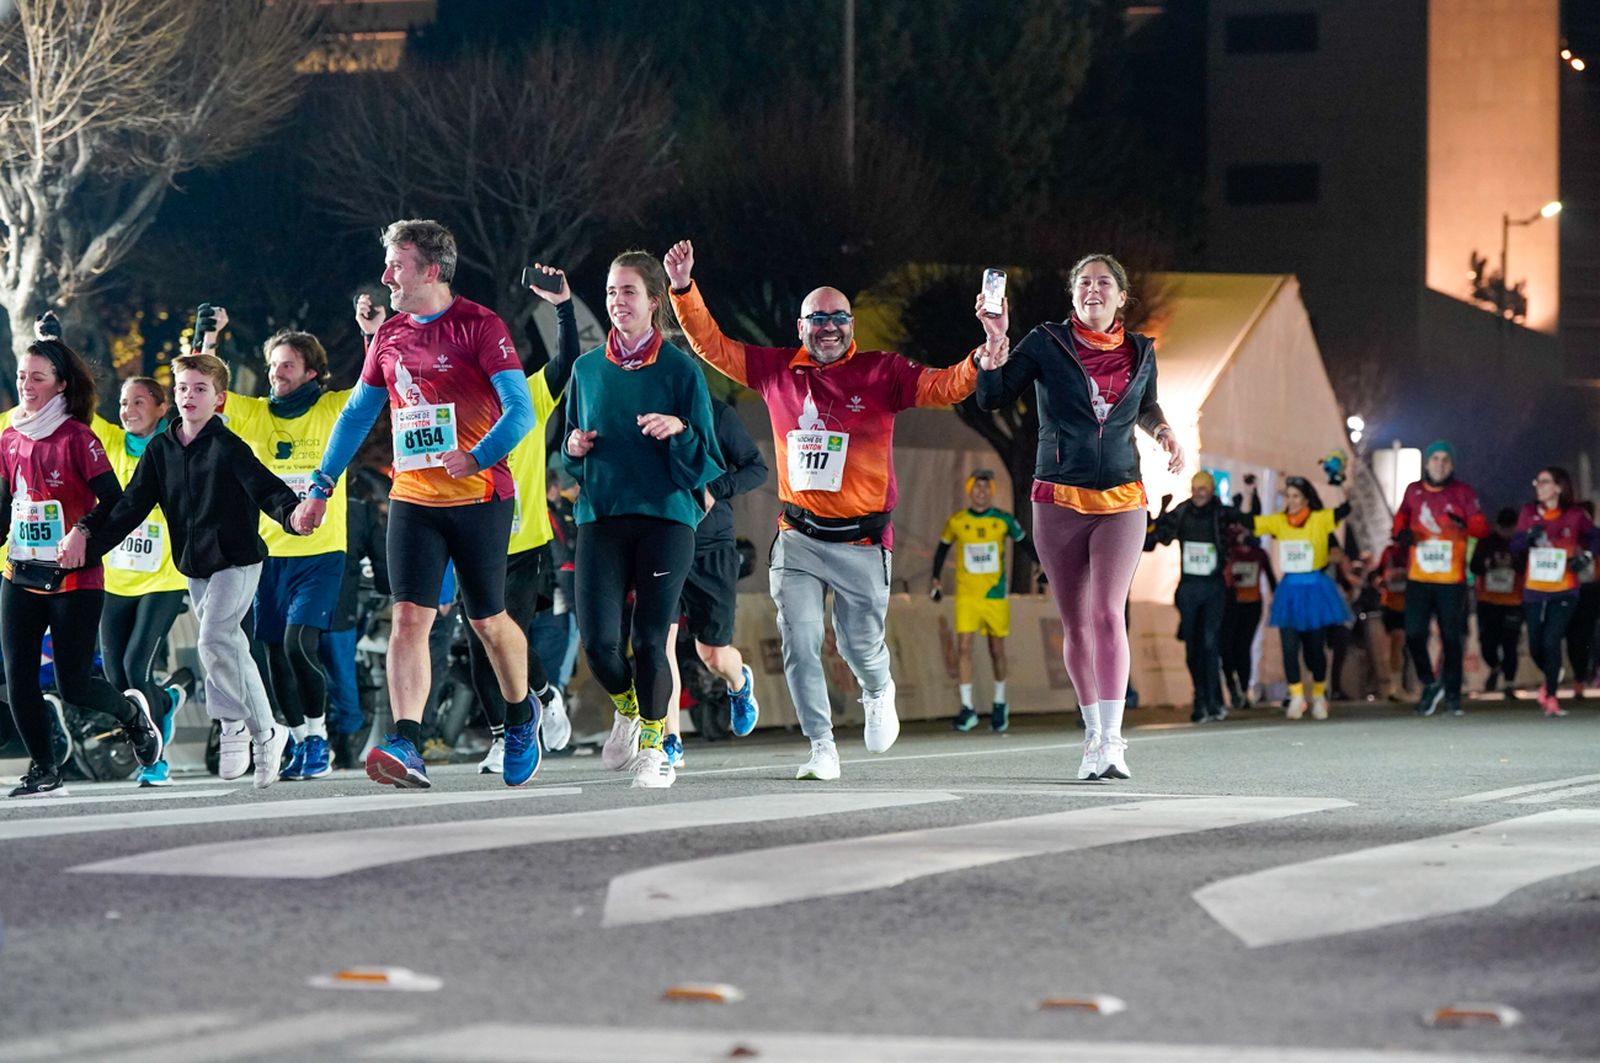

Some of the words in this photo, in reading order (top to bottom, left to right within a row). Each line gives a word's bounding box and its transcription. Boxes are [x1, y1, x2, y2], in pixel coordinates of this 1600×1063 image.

[405, 388, 421, 406] 43
[404, 427, 444, 449] 8154
[20, 522, 51, 541] 8155
